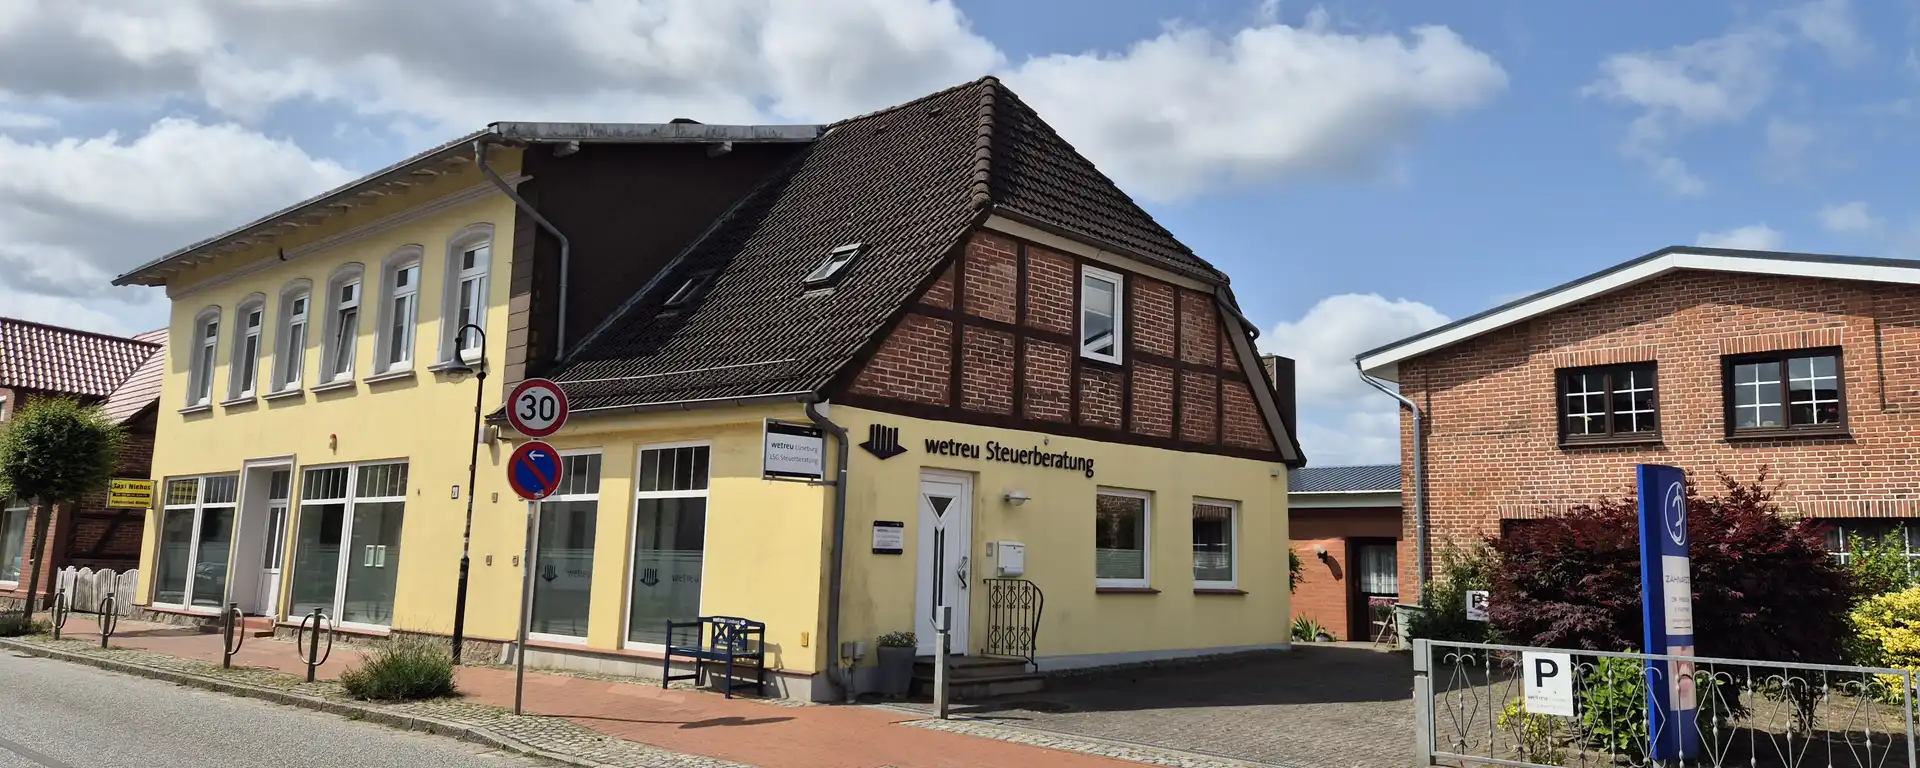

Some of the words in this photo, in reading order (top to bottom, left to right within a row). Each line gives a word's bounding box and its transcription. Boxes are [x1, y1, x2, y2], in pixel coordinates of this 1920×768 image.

[520, 394, 555, 421] 30
[771, 442, 794, 450] wetreu
[780, 455, 818, 465] Steuerberatung
[925, 437, 980, 459] wetreu
[986, 440, 1094, 478] Steuerberatung
[672, 573, 699, 583] wetreu
[1535, 658, 1559, 688] P
